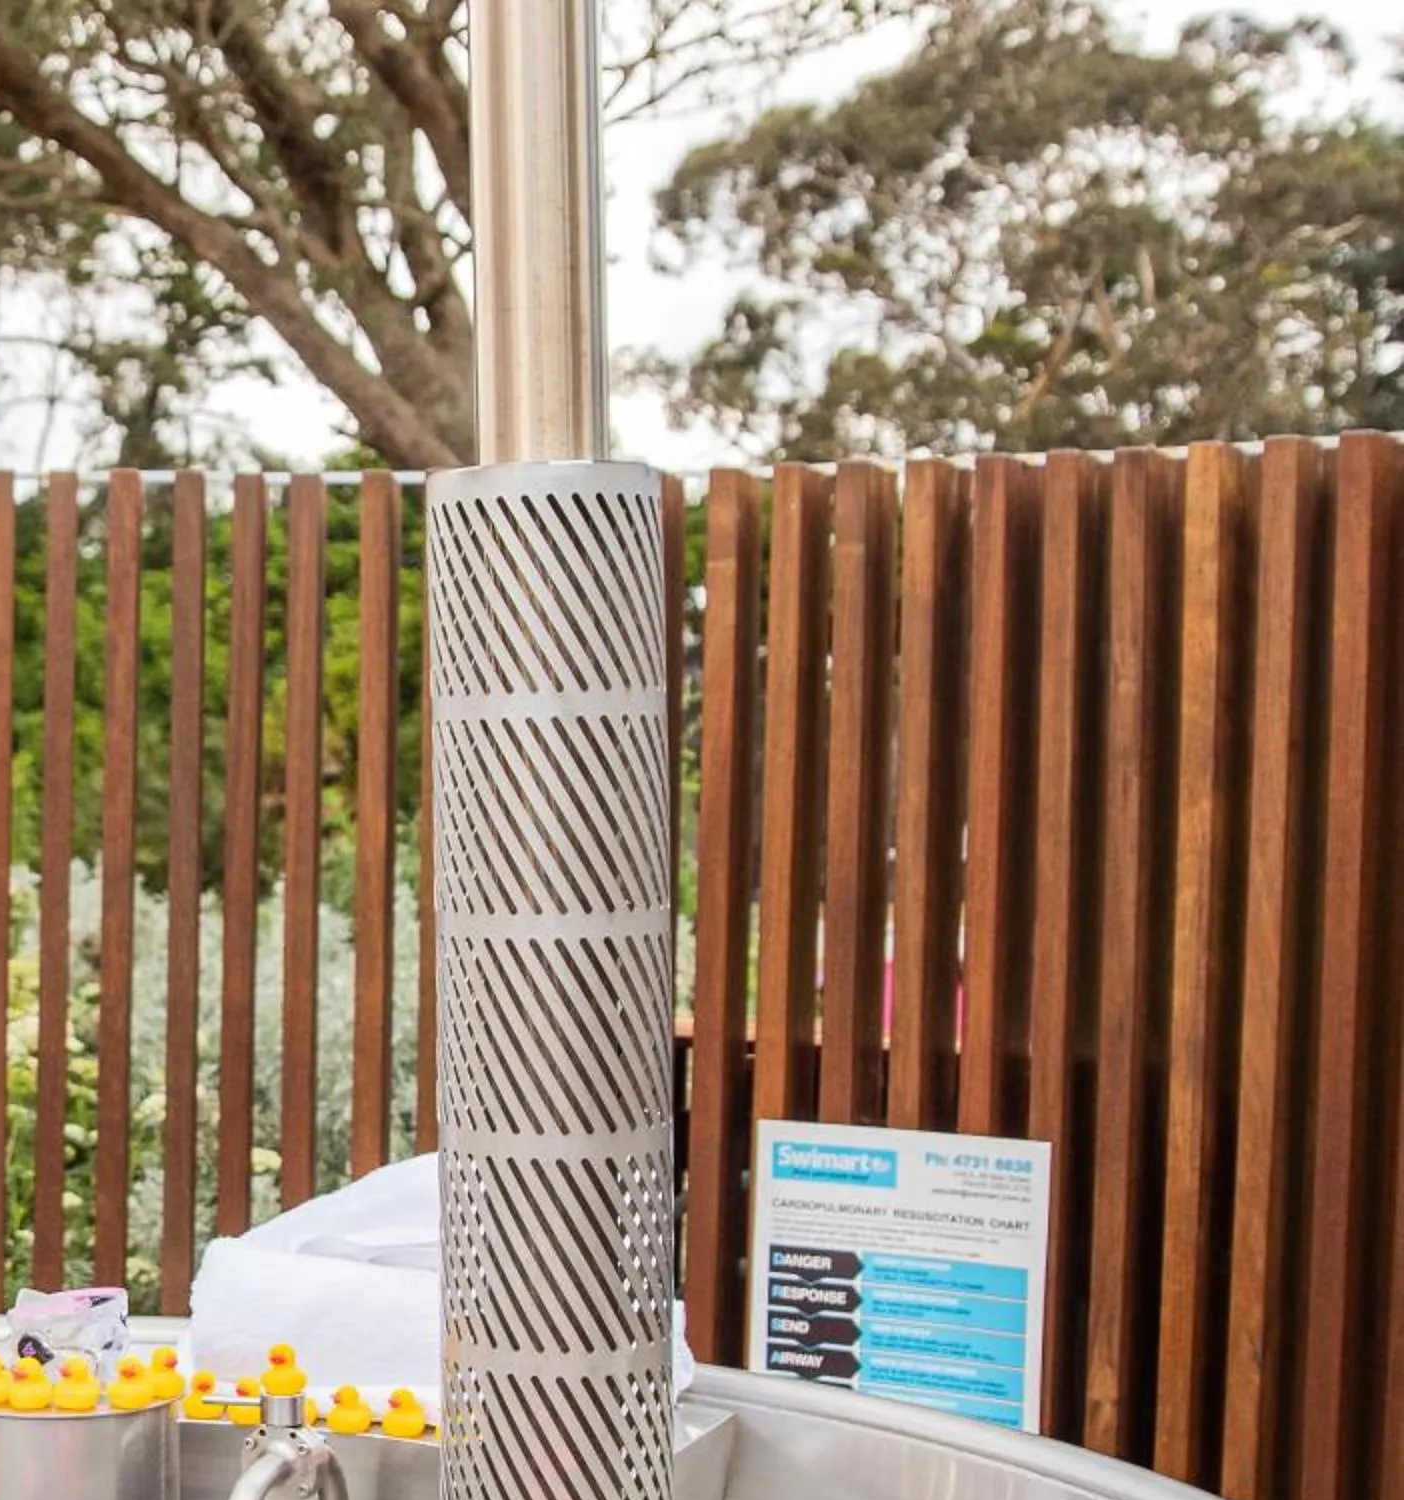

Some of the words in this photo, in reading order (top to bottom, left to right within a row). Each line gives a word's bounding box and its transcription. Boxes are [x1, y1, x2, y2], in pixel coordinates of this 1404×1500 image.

[777, 1144, 871, 1173] Swimart
[772, 1198, 887, 1216] CARDIOPULMONARY
[893, 1208, 984, 1226] RESUSCITATION
[989, 1217, 1029, 1231] CHART
[772, 1251, 832, 1271] DANGER
[771, 1284, 847, 1305] RESPONSE
[771, 1318, 810, 1335] SEND
[771, 1350, 824, 1369] AIRWAY
